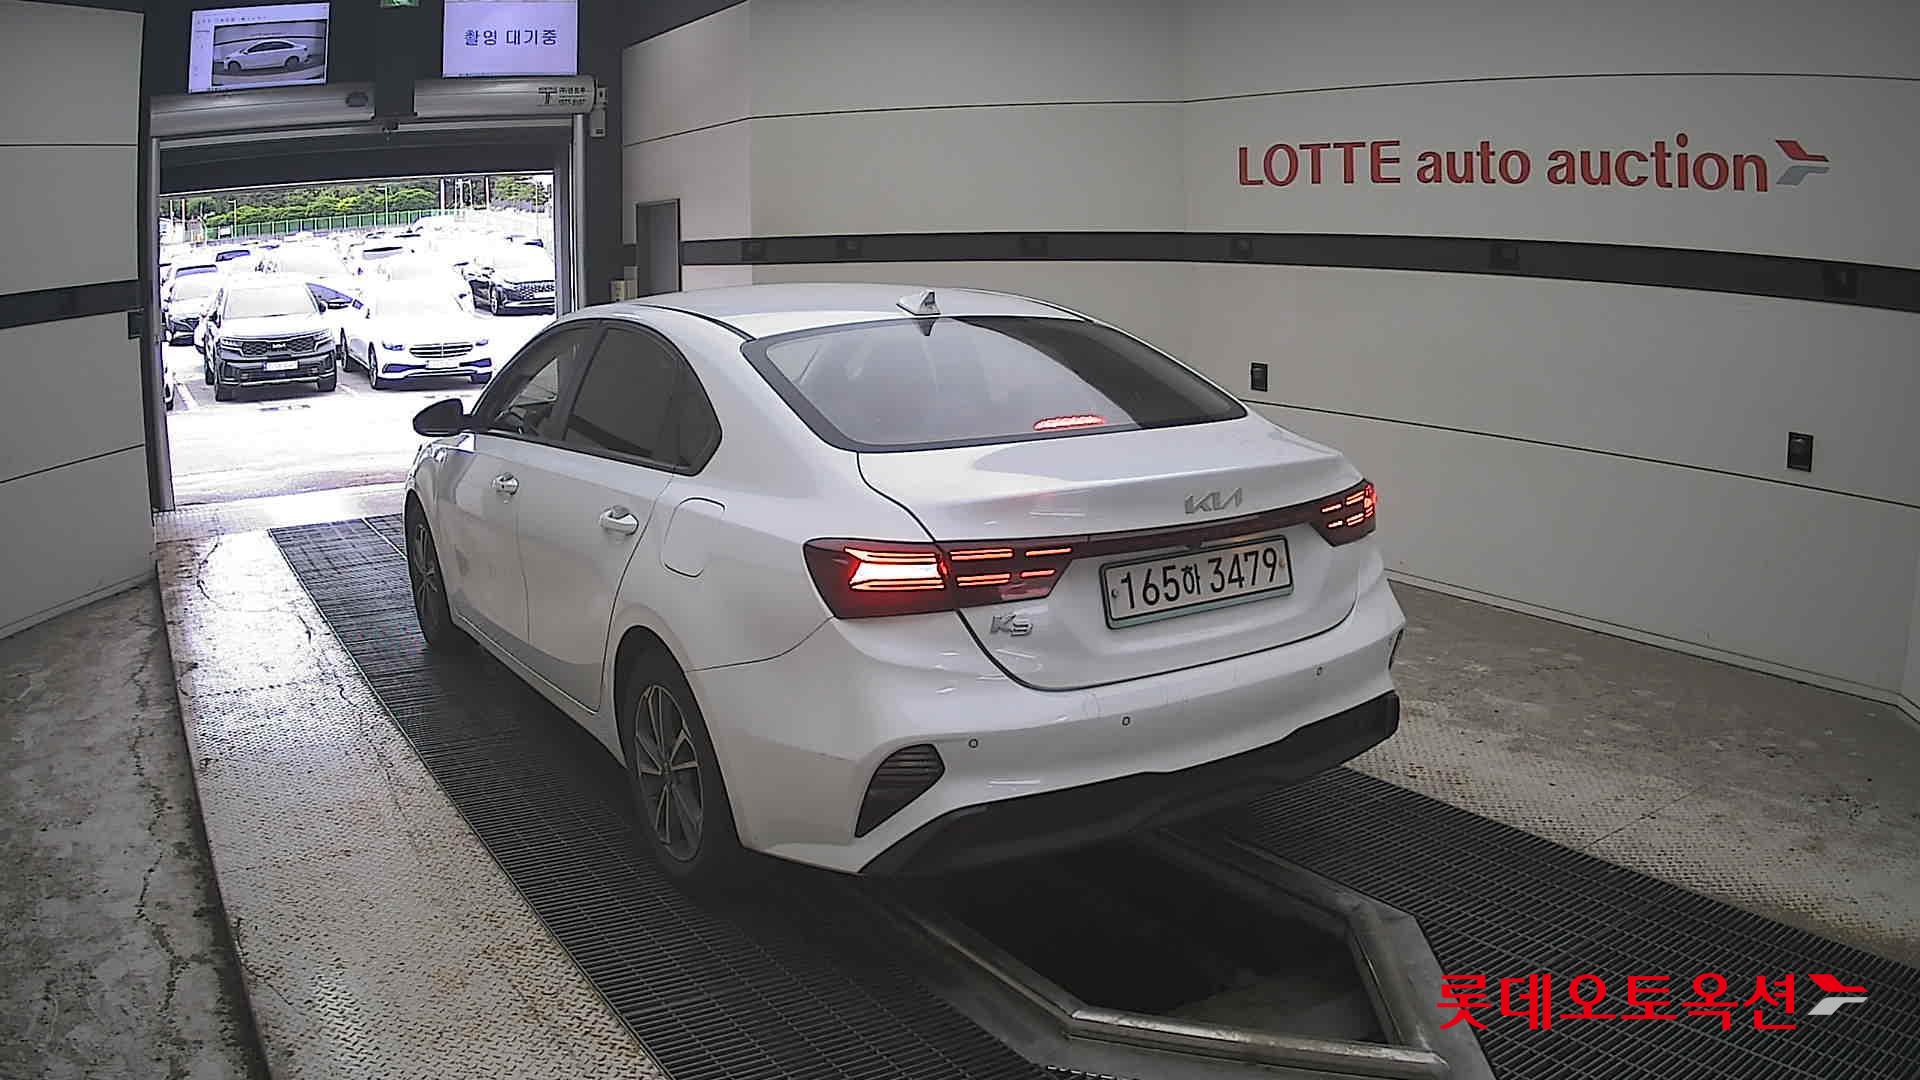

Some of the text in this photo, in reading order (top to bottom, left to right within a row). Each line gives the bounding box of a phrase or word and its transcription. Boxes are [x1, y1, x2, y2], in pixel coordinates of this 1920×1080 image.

[506, 29, 557, 46] 대기중
[1239, 134, 1769, 192] LOTTE auto auction
[1184, 488, 1243, 514] KIA
[1120, 547, 1279, 610] 165하 3479
[991, 612, 1033, 637] K3
